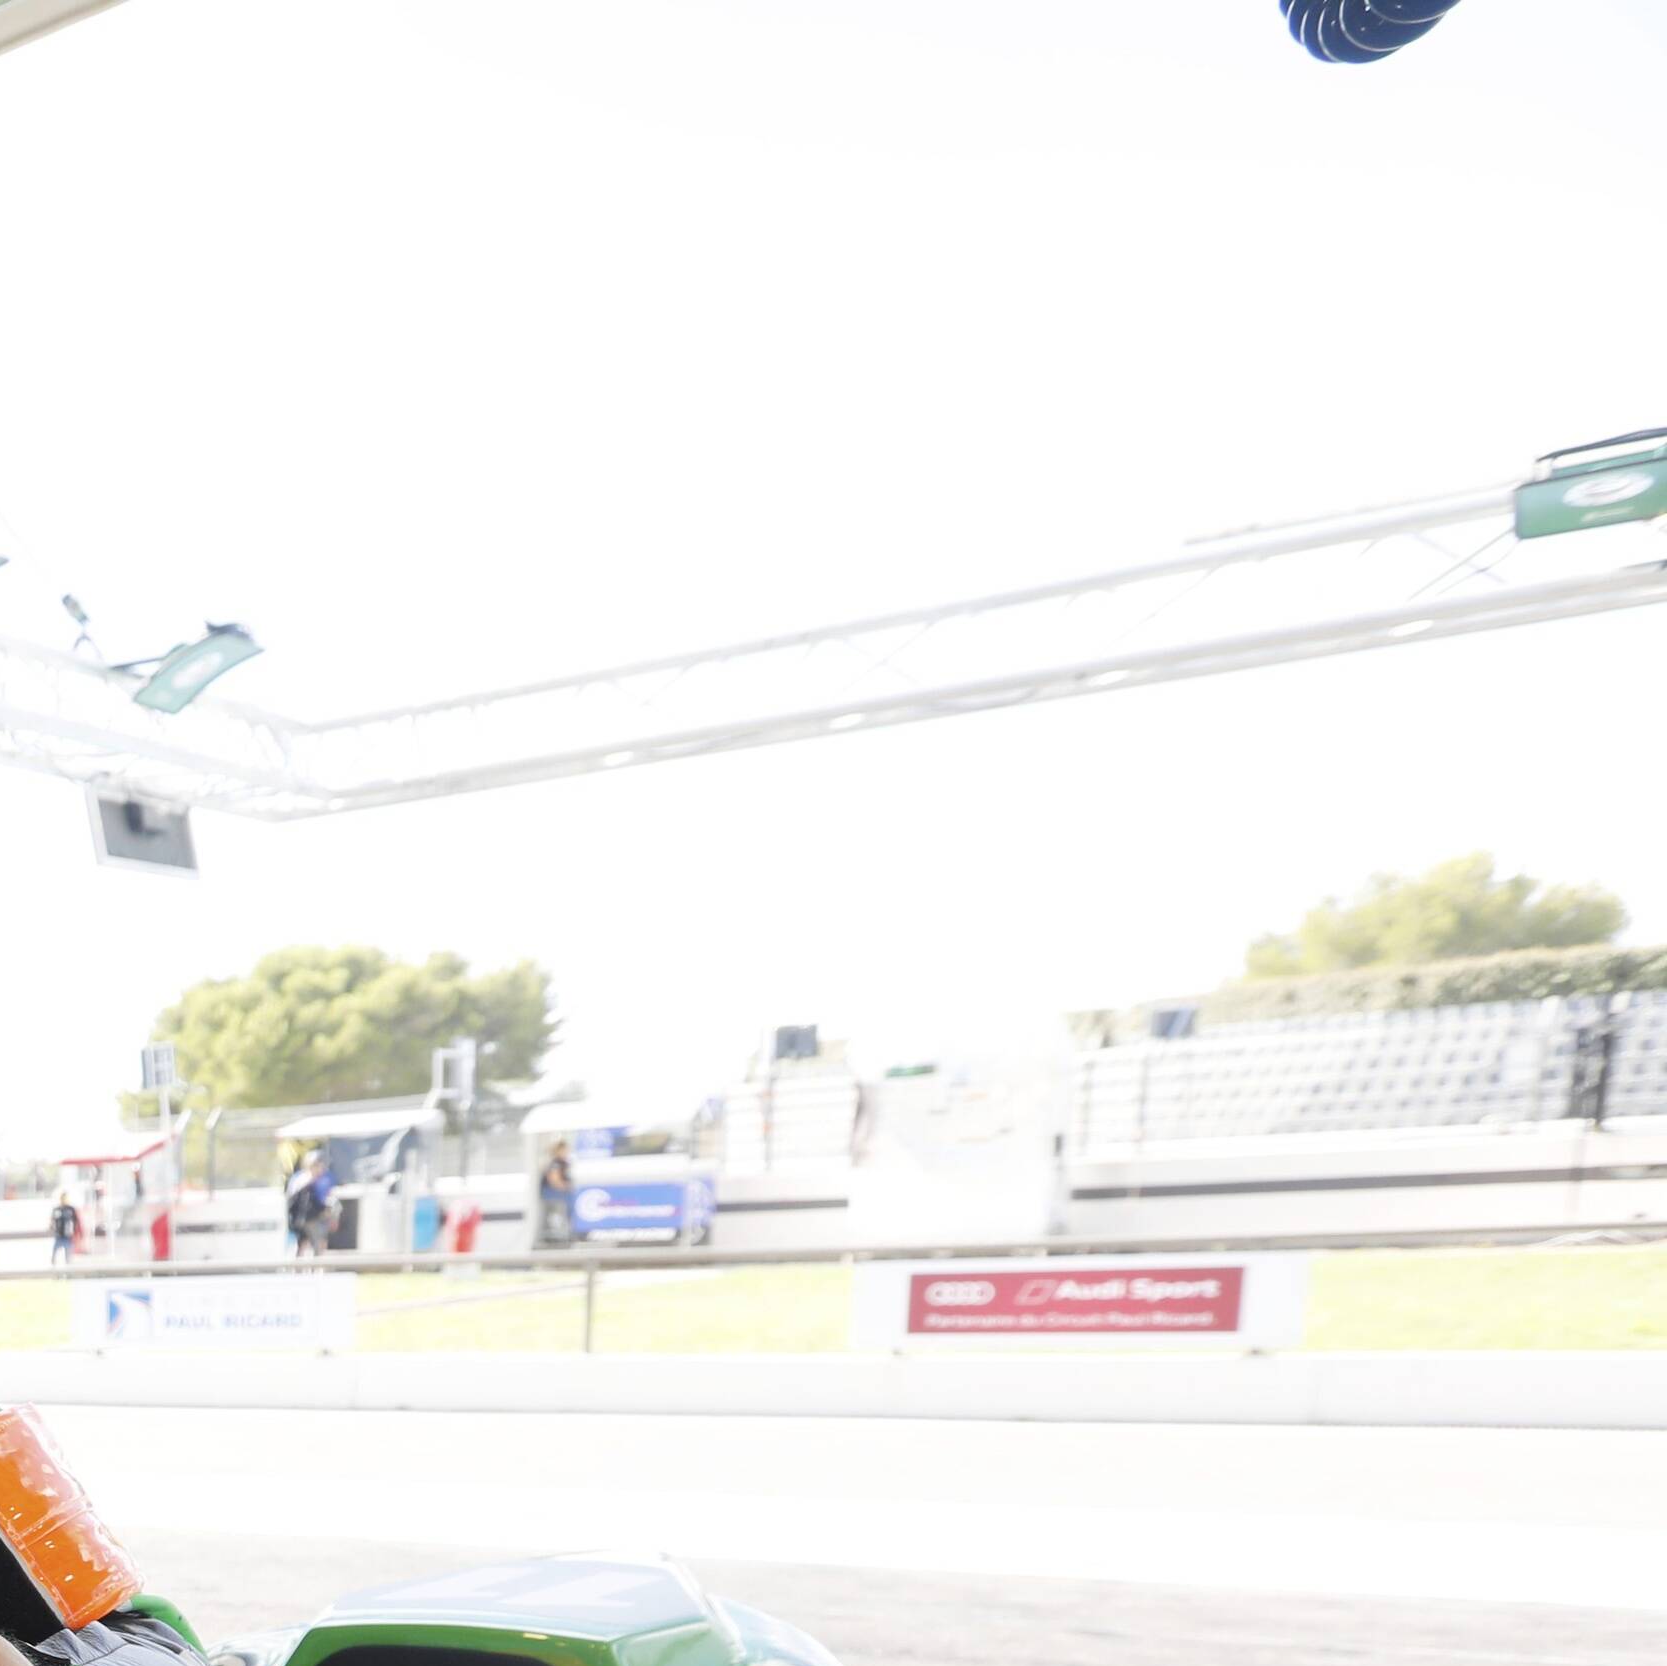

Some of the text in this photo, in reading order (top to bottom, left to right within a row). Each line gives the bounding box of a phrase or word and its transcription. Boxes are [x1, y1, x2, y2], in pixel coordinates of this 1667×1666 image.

[1055, 1278, 1222, 1302] Audi Sport
[163, 1312, 304, 1330] PAUL RICARD
